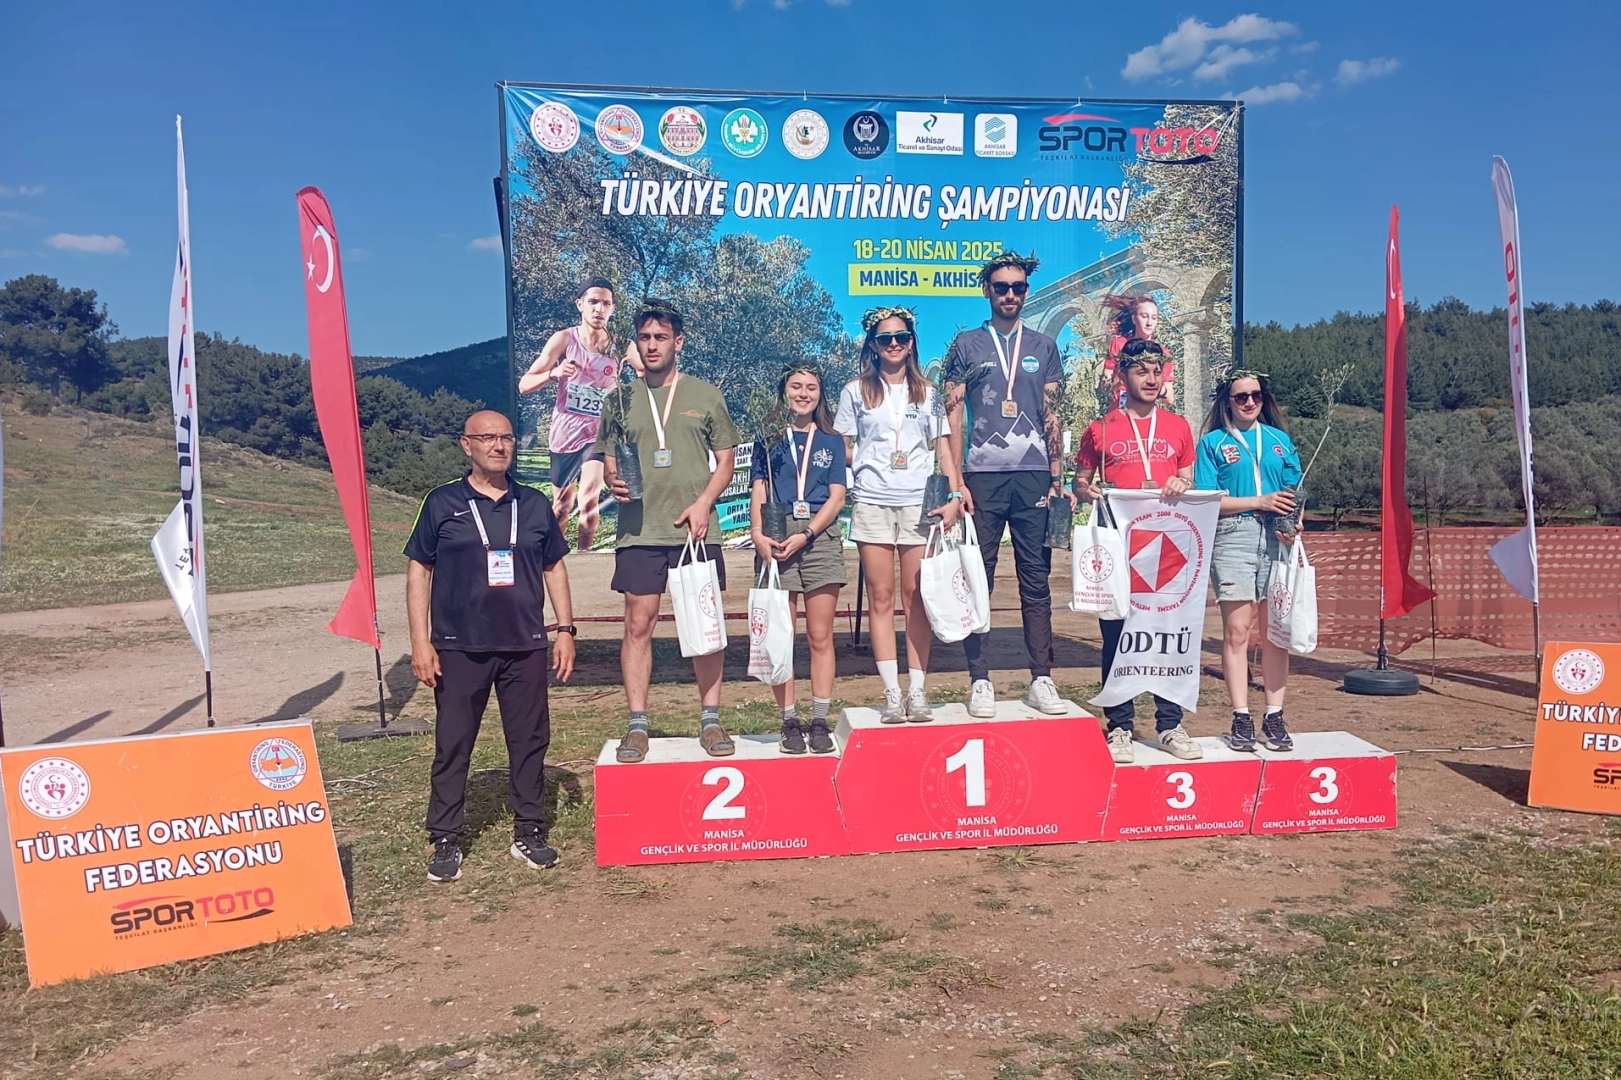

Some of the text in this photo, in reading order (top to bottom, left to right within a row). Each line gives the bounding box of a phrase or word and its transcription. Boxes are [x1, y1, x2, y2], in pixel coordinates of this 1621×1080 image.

[916, 136, 945, 144] Akhisar
[1038, 126, 1218, 154] SPOR TOTO
[600, 172, 1130, 229] TÜRKİYE ORYANTİRİNG ŞAMPİYONASI
[854, 236, 1004, 262] 18-20 NİSAN 2025
[859, 267, 918, 287] MANİSA
[575, 397, 604, 412] 123
[1119, 627, 1192, 655] ODTÜ
[1113, 664, 1194, 678] ORIENTEERING
[946, 738, 986, 806] 1
[701, 766, 746, 820] 2
[1166, 771, 1196, 809] 3
[1309, 766, 1339, 804] 3
[957, 815, 996, 826] MANİSA
[1166, 814, 1197, 822] MANİSA
[1262, 820, 1294, 828] GENÇLİK
[1336, 815, 1386, 824] MÜDÜRLÜĞÜ
[1309, 808, 1339, 816] MANİSA
[16, 801, 326, 864] TÜRKİYE ORYANTİRİNG
[704, 829, 744, 839] MANİSA
[896, 831, 938, 843] GENÇLİK
[955, 830, 980, 839] SPOR
[983, 827, 992, 837] İL
[994, 824, 1058, 837] MÜDÜRLÜĞÜ
[1119, 826, 1152, 834] GENÇLİK
[1194, 820, 1244, 829] MÜDÜRLÜĞÜ
[641, 837, 808, 856] GENÇLİK VE SPOR İL MÜDÜRLÜĞÜ
[84, 842, 282, 892] FEDERASYONU
[110, 886, 274, 934] SPOR TOTO
[115, 922, 198, 940] TEŞKİLAT BAŞKANLIĞI
